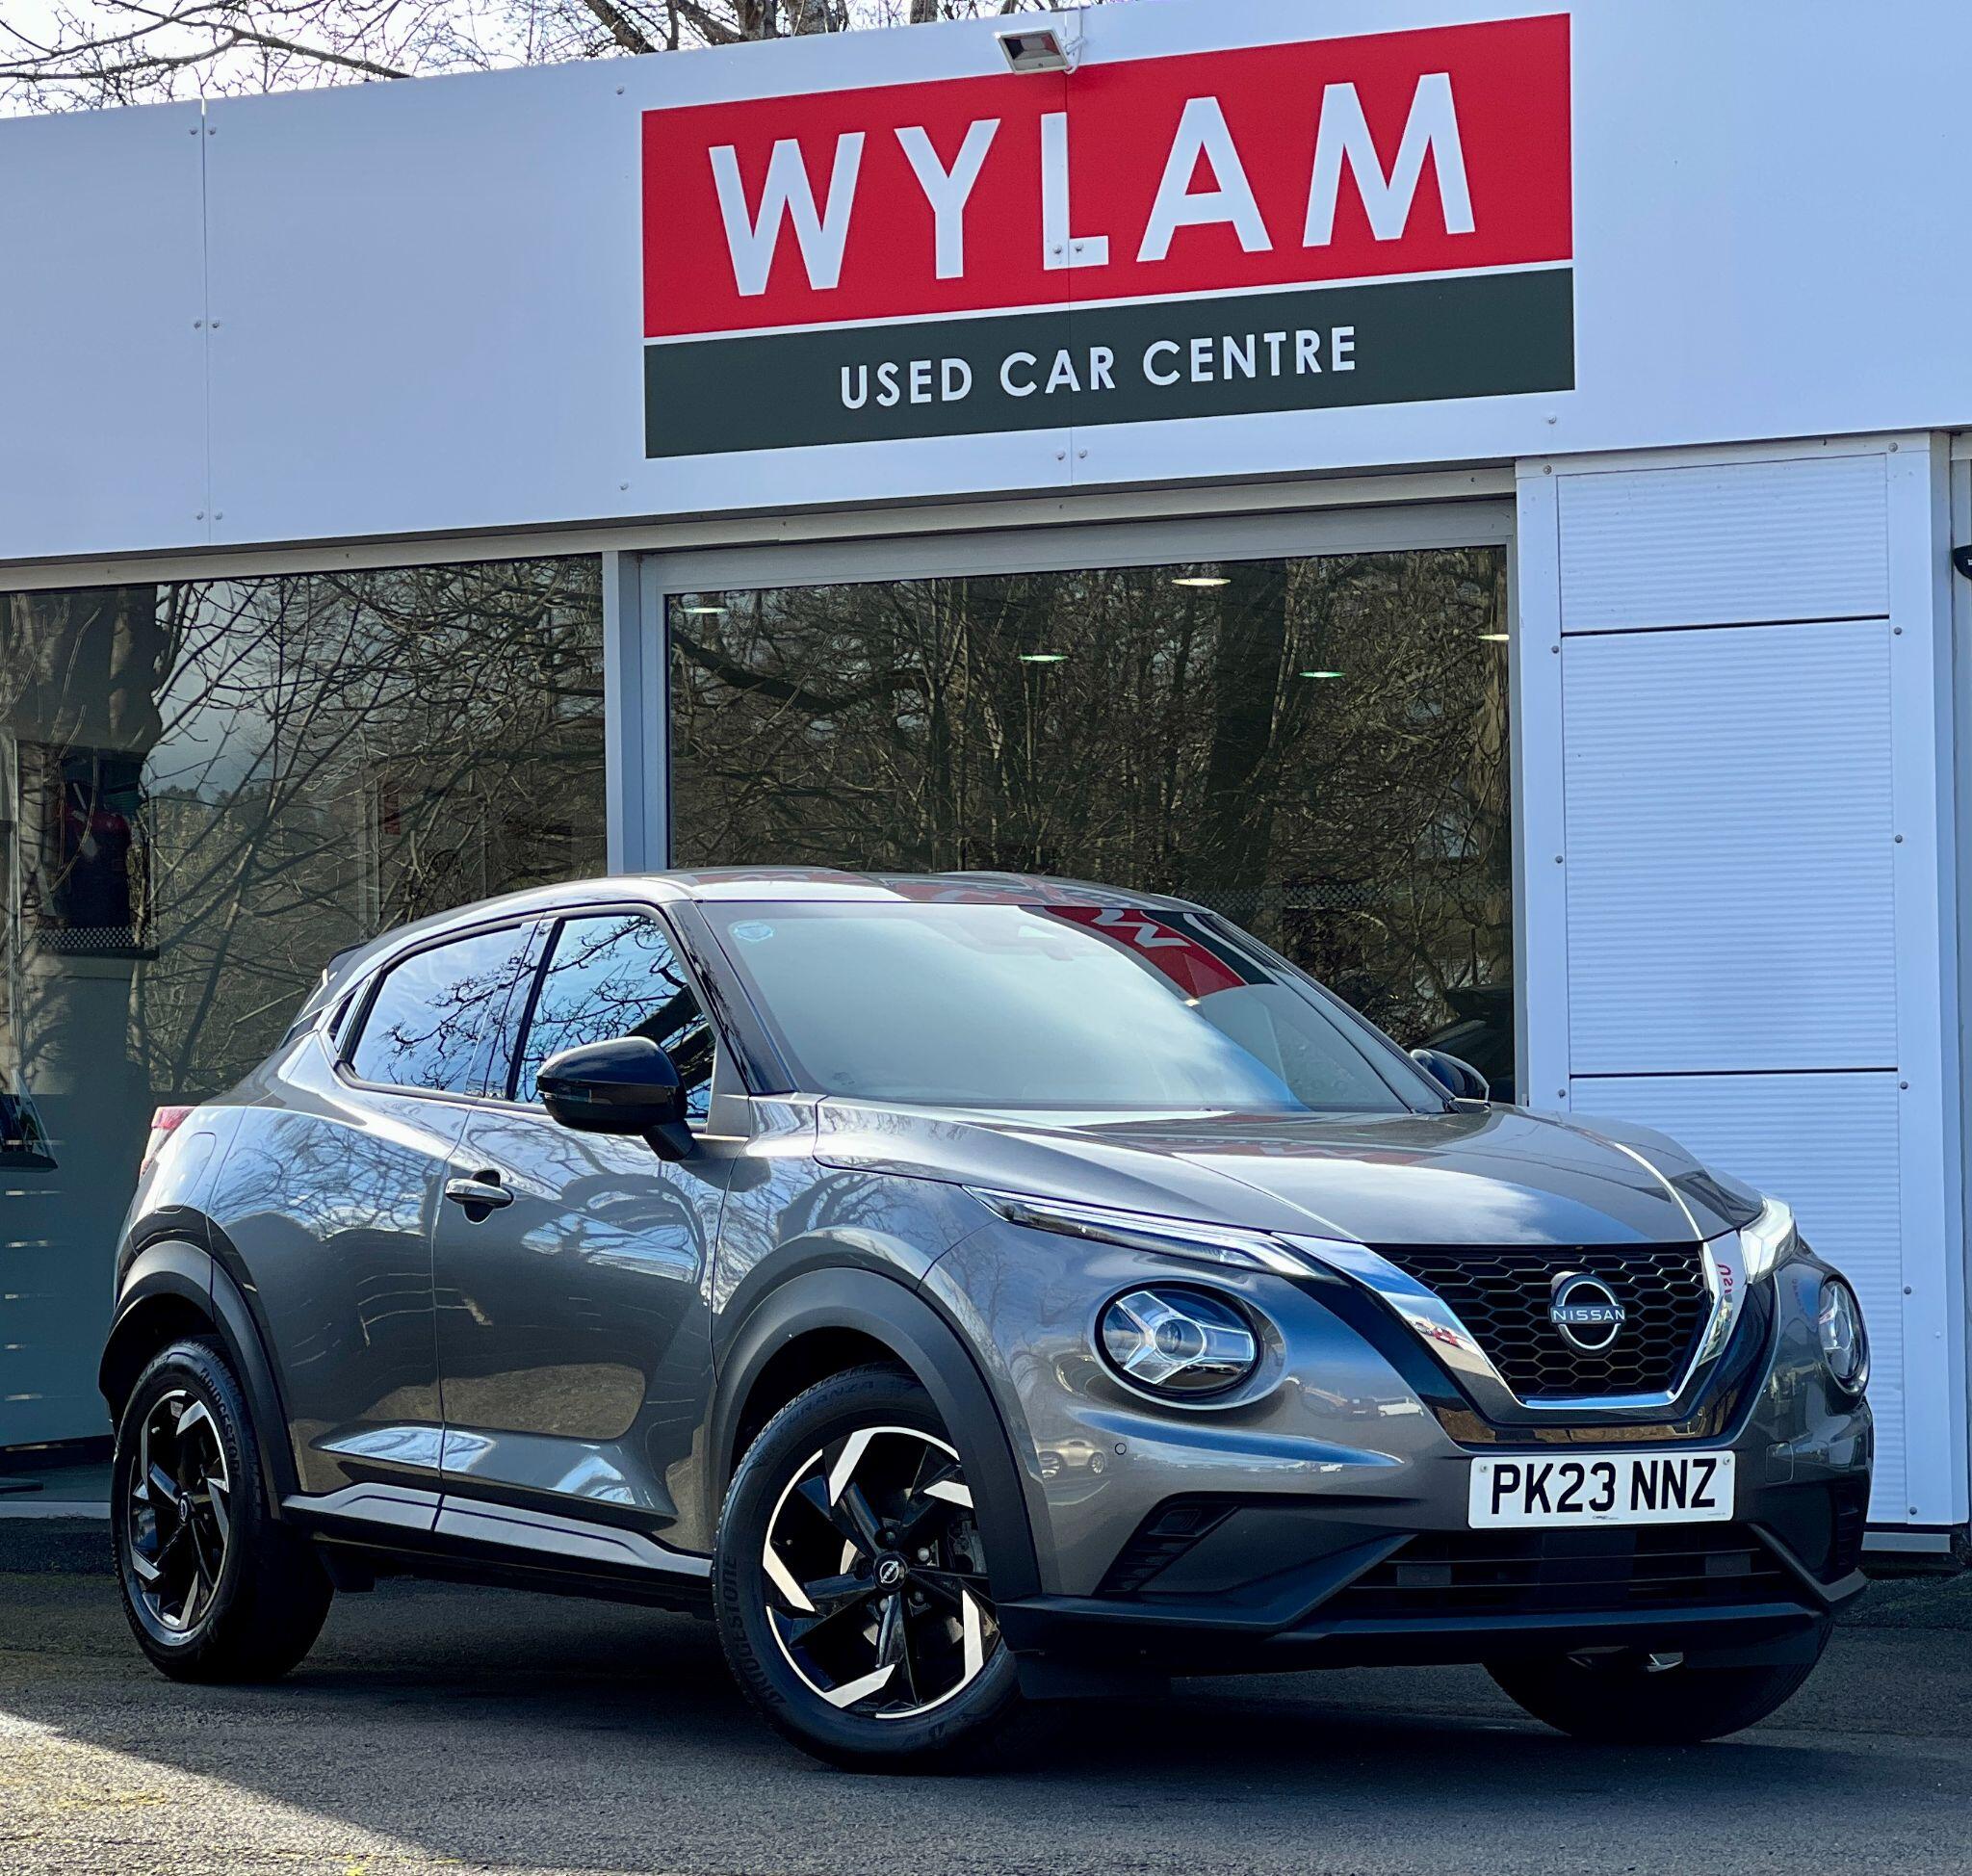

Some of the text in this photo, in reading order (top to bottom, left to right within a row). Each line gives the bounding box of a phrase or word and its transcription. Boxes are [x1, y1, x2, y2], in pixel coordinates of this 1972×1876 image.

[709, 73, 1475, 296] WYLAM
[842, 326, 1355, 408] USED CAR CENTRE
[1552, 1309, 1625, 1321] NISSAN
[1492, 1458, 1716, 1514] PK23 NNZ
